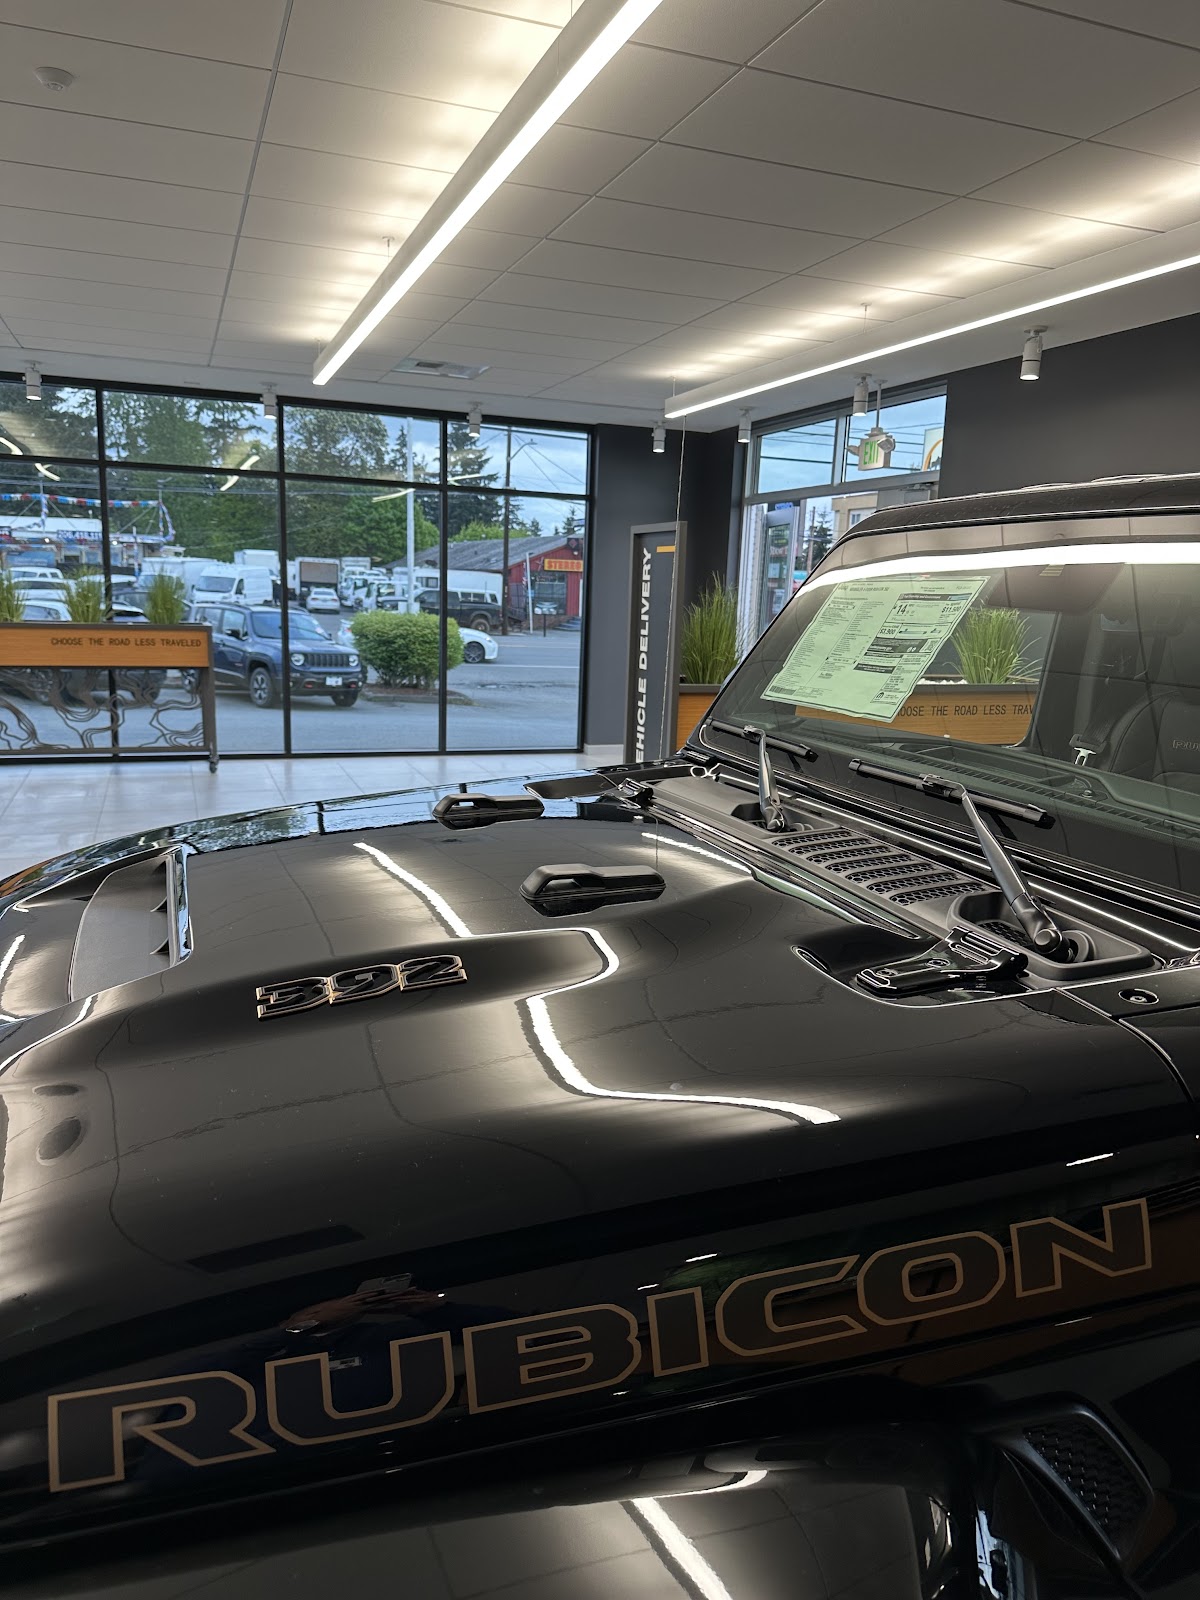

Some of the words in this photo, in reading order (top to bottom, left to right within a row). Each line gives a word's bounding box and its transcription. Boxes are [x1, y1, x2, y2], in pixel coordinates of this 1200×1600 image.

[863, 440, 880, 465] EXIT
[547, 560, 582, 571] STEREO
[638, 547, 652, 670] DELIVERY
[896, 604, 908, 614] 14
[51, 637, 83, 646] CHOOSE
[89, 638, 103, 646] THE
[109, 638, 130, 646] ROAD
[135, 638, 156, 647] LESS
[161, 638, 201, 647] TRAVELED
[635, 678, 647, 764] EHICLE
[898, 706, 924, 717] OOSE
[931, 706, 948, 716] THE
[954, 705, 978, 715] ROAD
[983, 705, 1006, 715] LESS
[255, 955, 467, 1019] 392
[48, 1198, 1153, 1492] RUBICON
